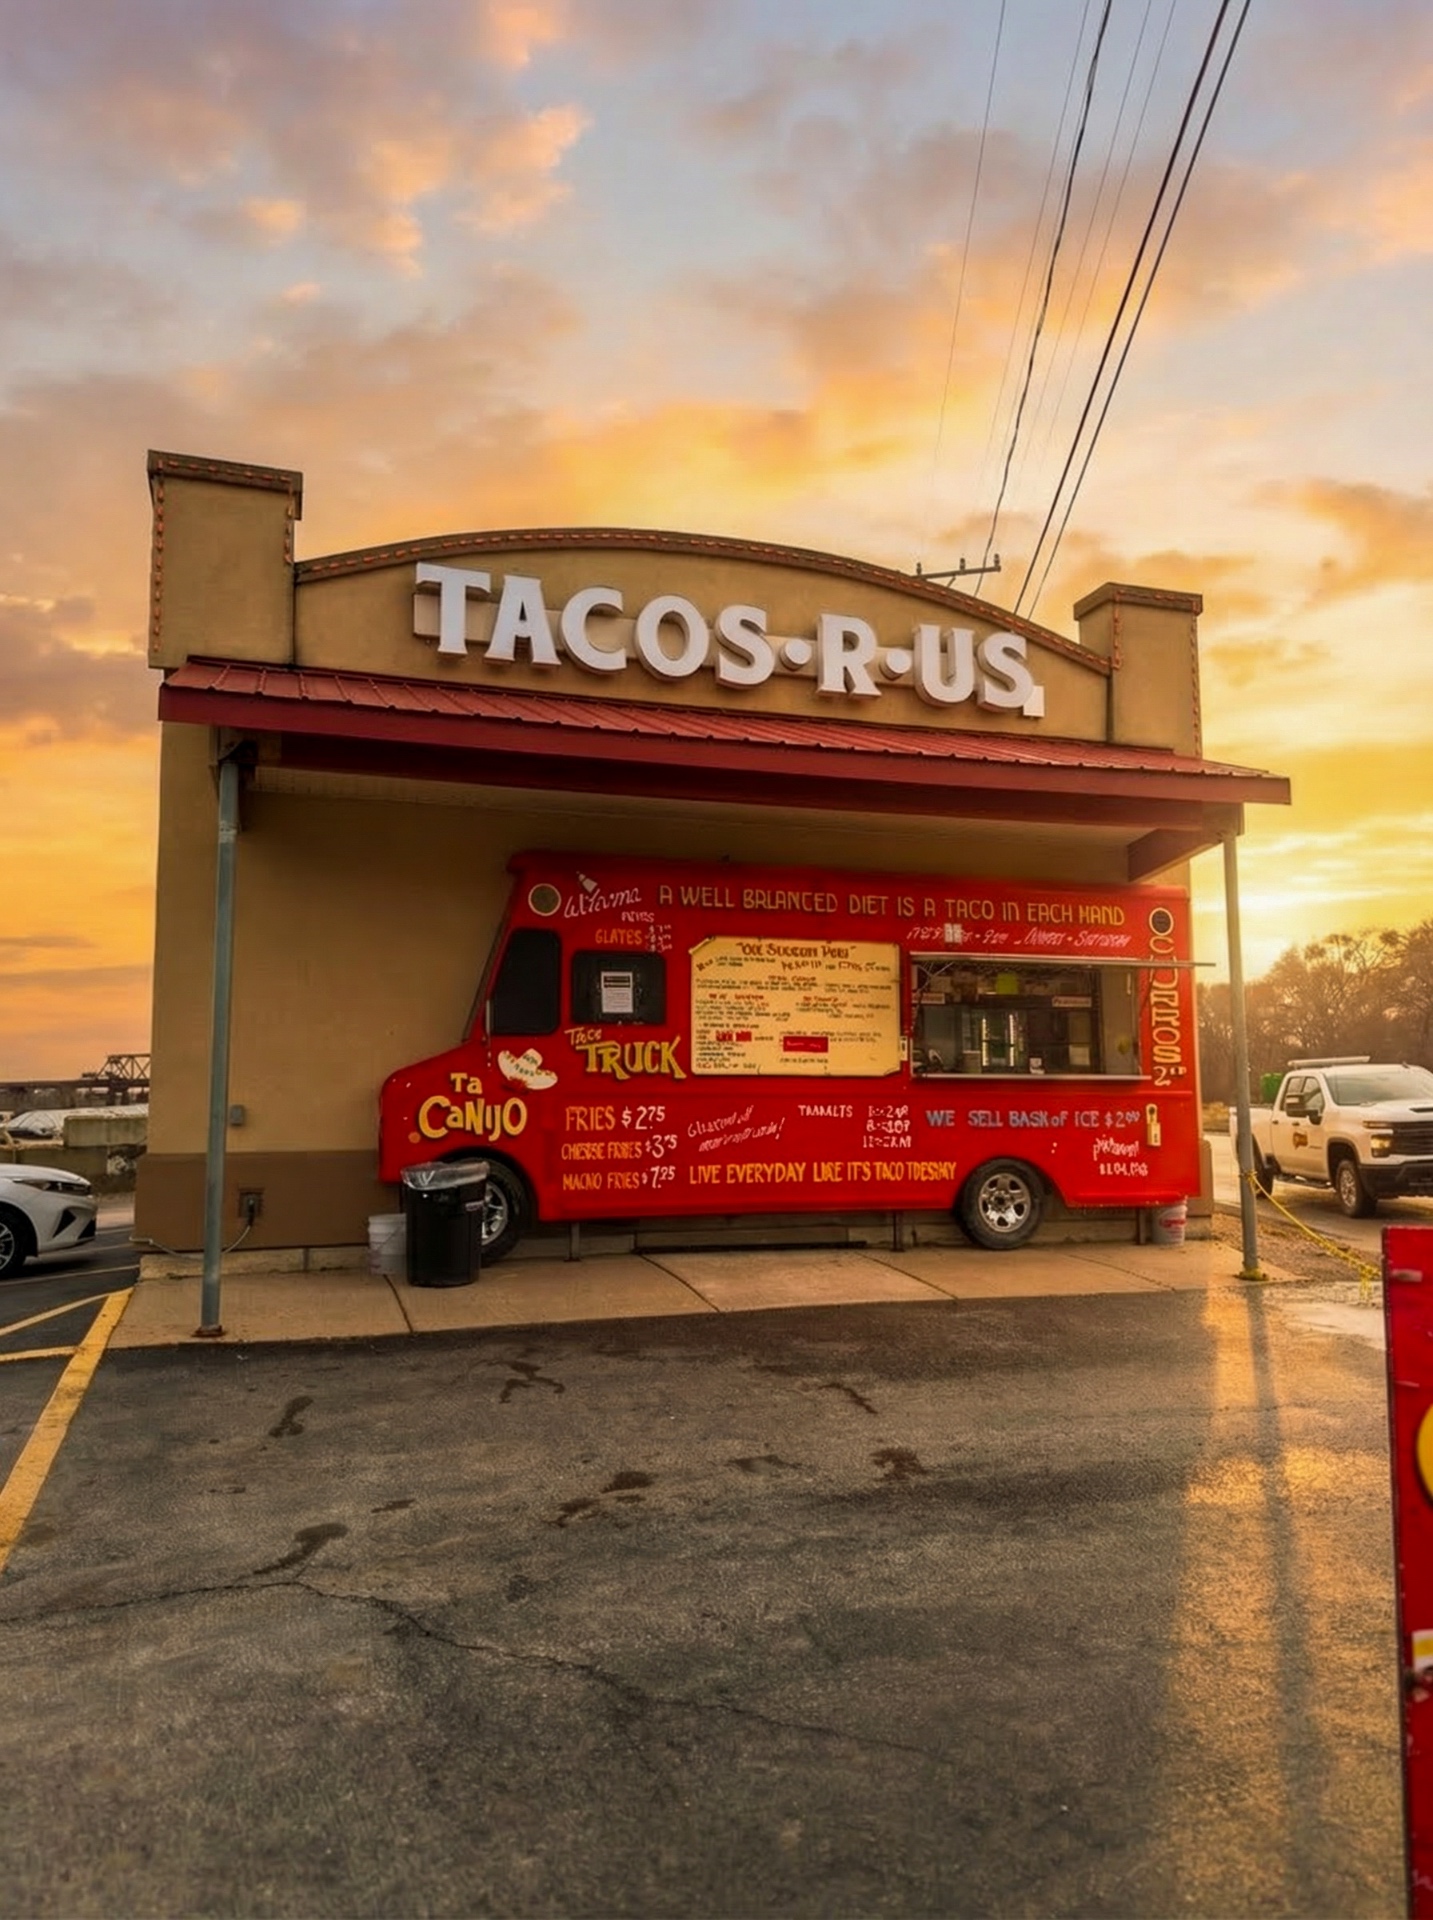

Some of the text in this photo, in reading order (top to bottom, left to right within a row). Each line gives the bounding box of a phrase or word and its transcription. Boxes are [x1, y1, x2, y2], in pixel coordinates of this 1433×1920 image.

[414, 561, 777, 689] TACOS
[659, 885, 673, 905] A
[680, 886, 735, 908] WELL
[849, 894, 889, 915] DIET
[897, 896, 915, 917] IS
[924, 898, 936, 917] A
[945, 899, 994, 920] TACO
[1027, 903, 1073, 923] EACH
[1079, 905, 1125, 926] HAND
[575, 1034, 687, 1080] TRUCK
[450, 1072, 483, 1095] Ta
[565, 1105, 615, 1131] FRIES
[926, 1110, 955, 1127] WE
[968, 1110, 1003, 1127] SELL
[1074, 1110, 1099, 1128] ICE
[689, 1165, 722, 1184] LIVE
[726, 1162, 806, 1184] EVERYDAY
[873, 1161, 904, 1181] TACO
